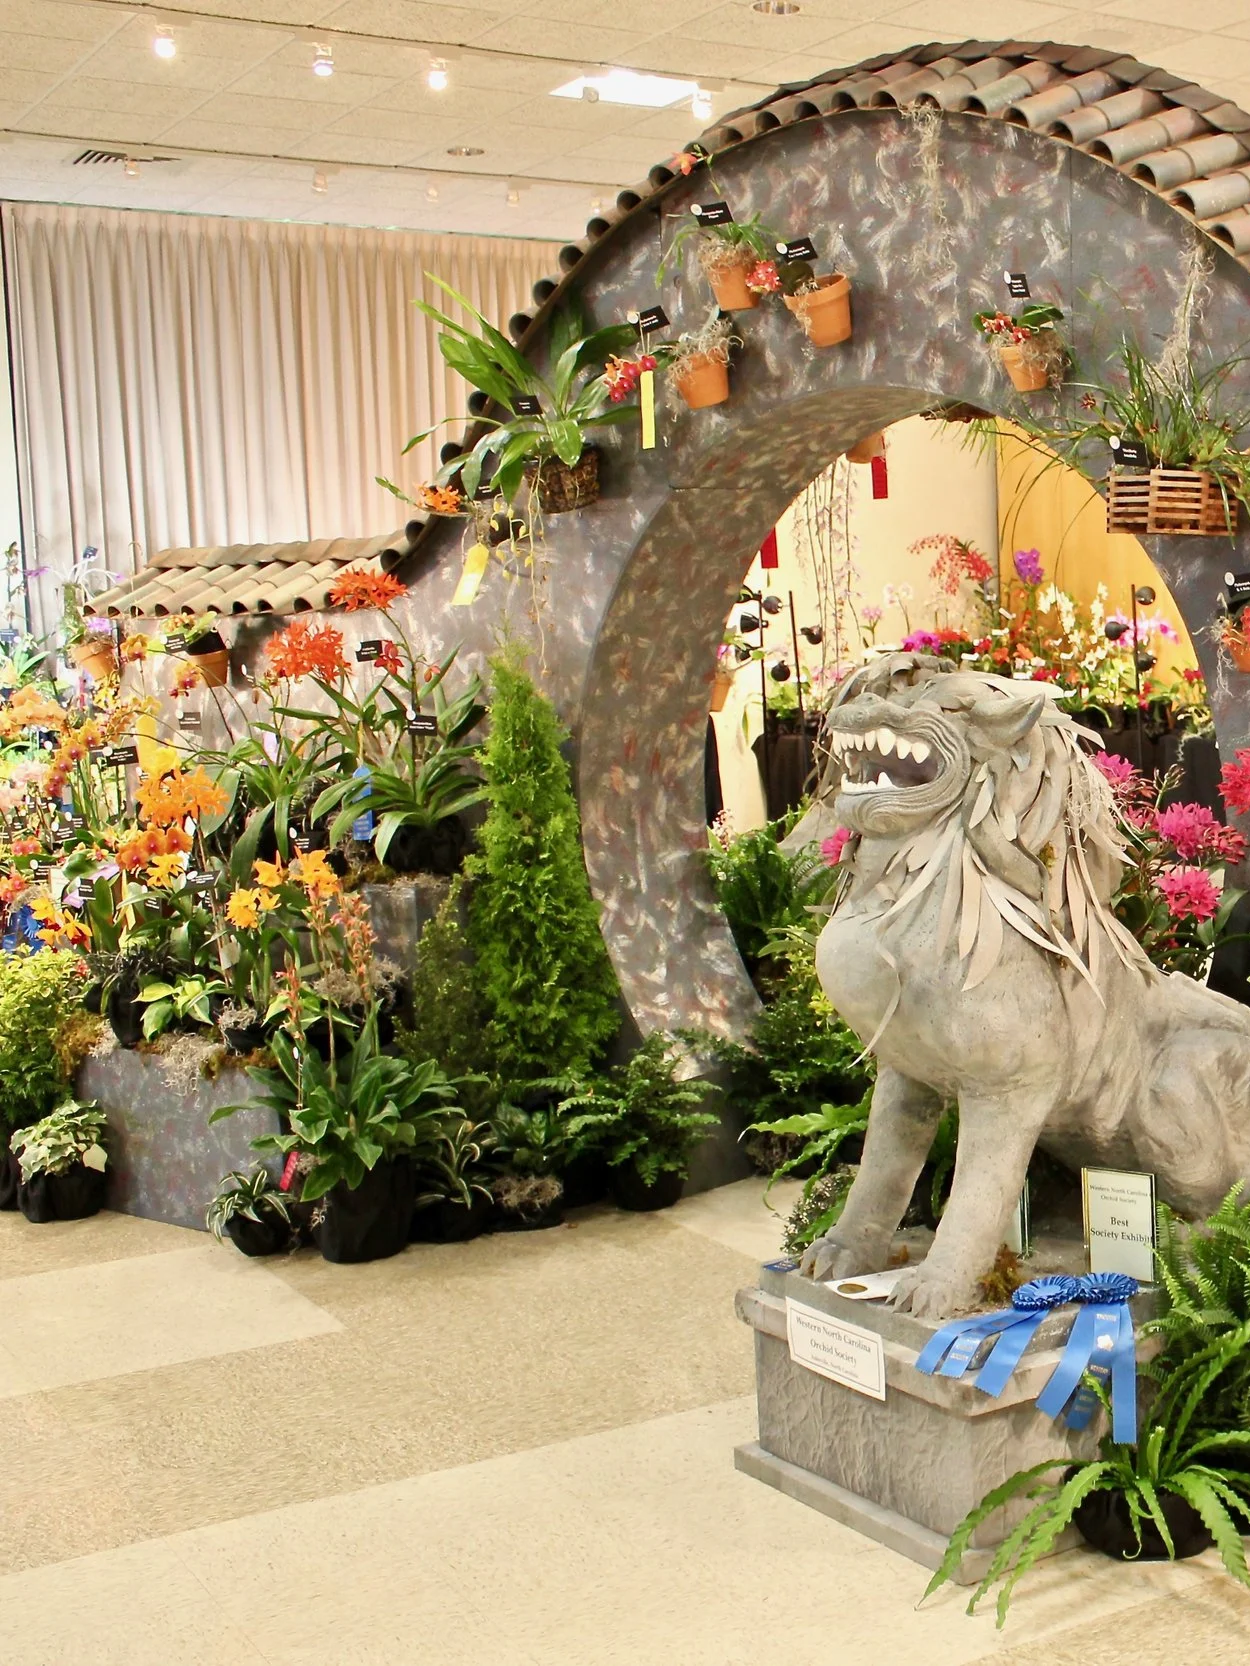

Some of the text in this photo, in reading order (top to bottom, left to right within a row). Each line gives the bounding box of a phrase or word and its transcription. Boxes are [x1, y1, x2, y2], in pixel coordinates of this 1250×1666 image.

[1100, 1194, 1118, 1202] Orchid
[1110, 1187, 1126, 1195] North
[1126, 1189, 1148, 1197] Carolina
[1110, 1216, 1129, 1228] Best
[1090, 1227, 1119, 1241] Society
[796, 1316, 871, 1354] Western North Carolina
[810, 1338, 857, 1368] Orchid Society
